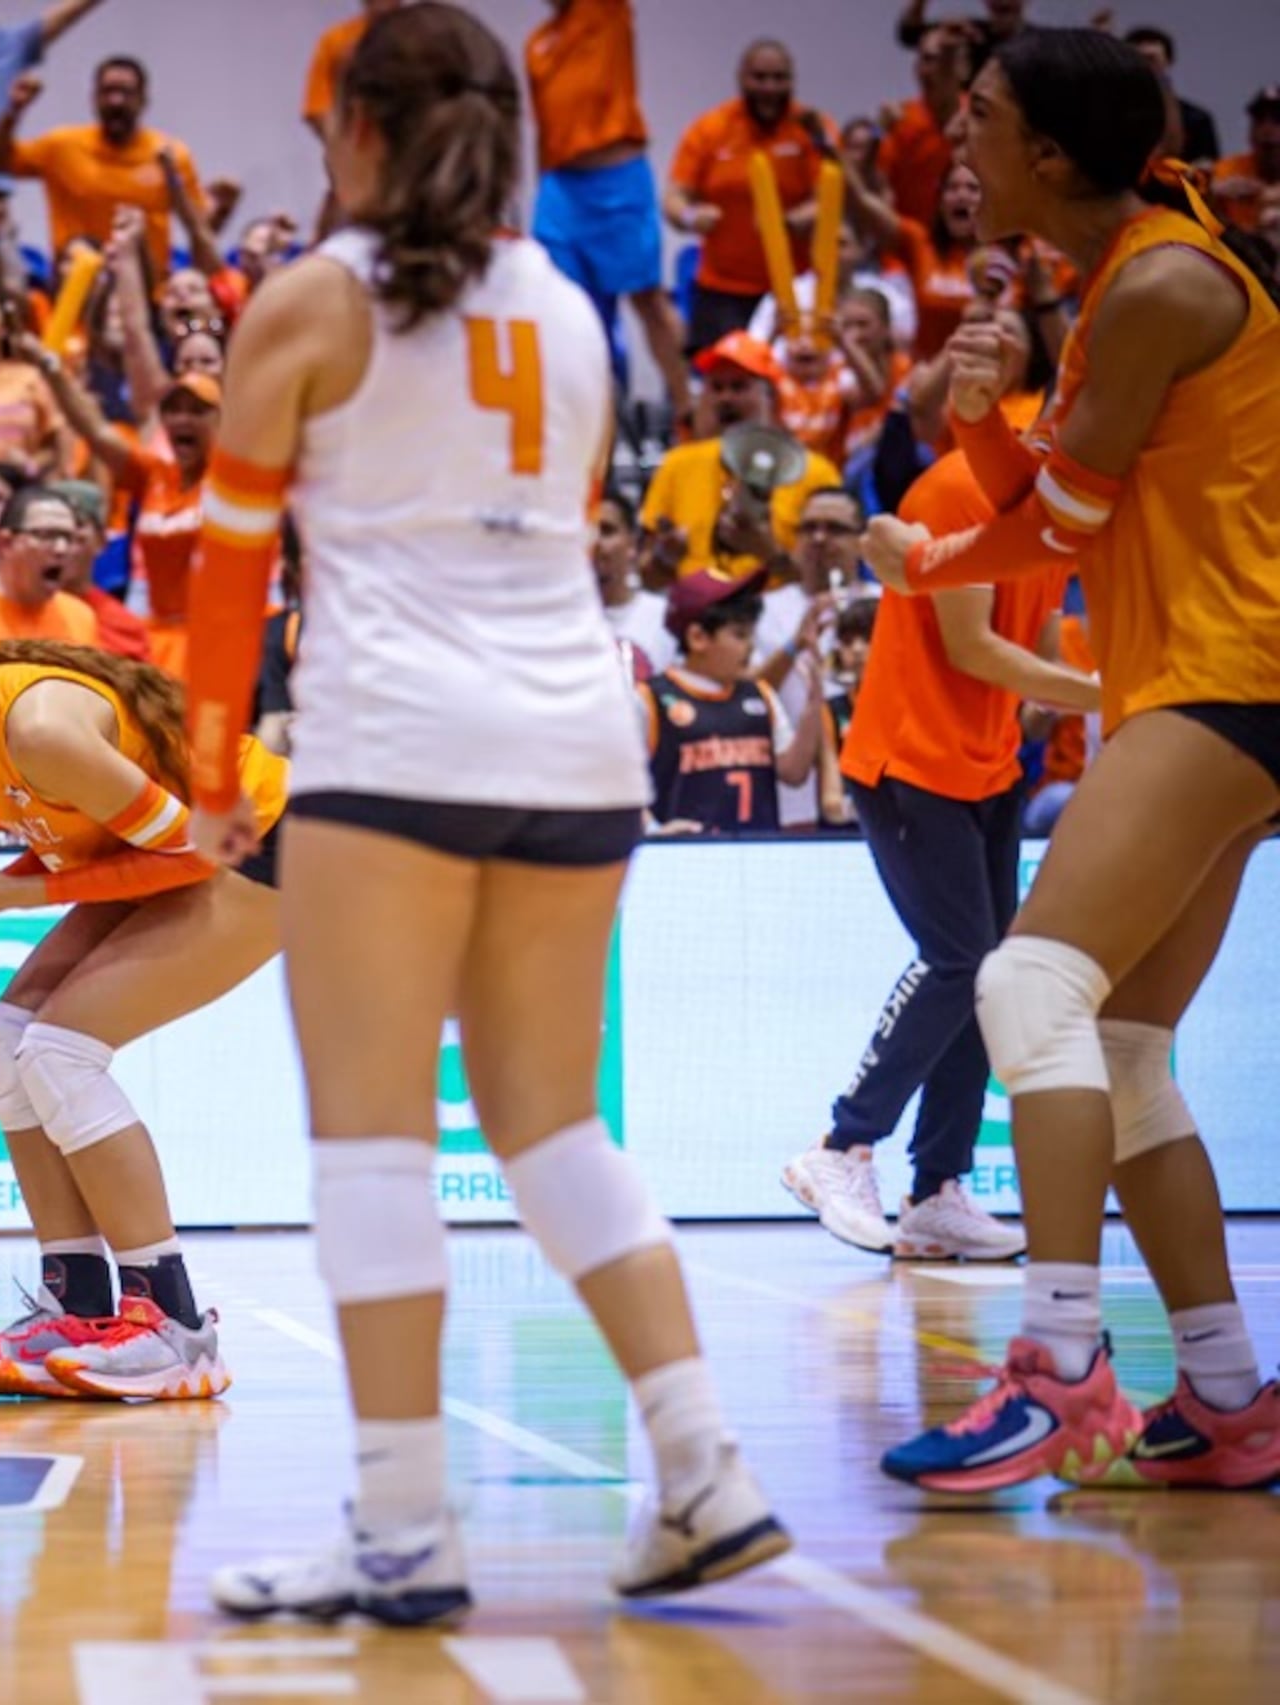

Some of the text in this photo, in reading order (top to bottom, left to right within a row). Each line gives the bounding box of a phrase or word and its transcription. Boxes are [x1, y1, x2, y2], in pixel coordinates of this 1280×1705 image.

[465, 313, 544, 477] 4
[724, 769, 753, 823] 7
[880, 959, 932, 1040] NIKE
